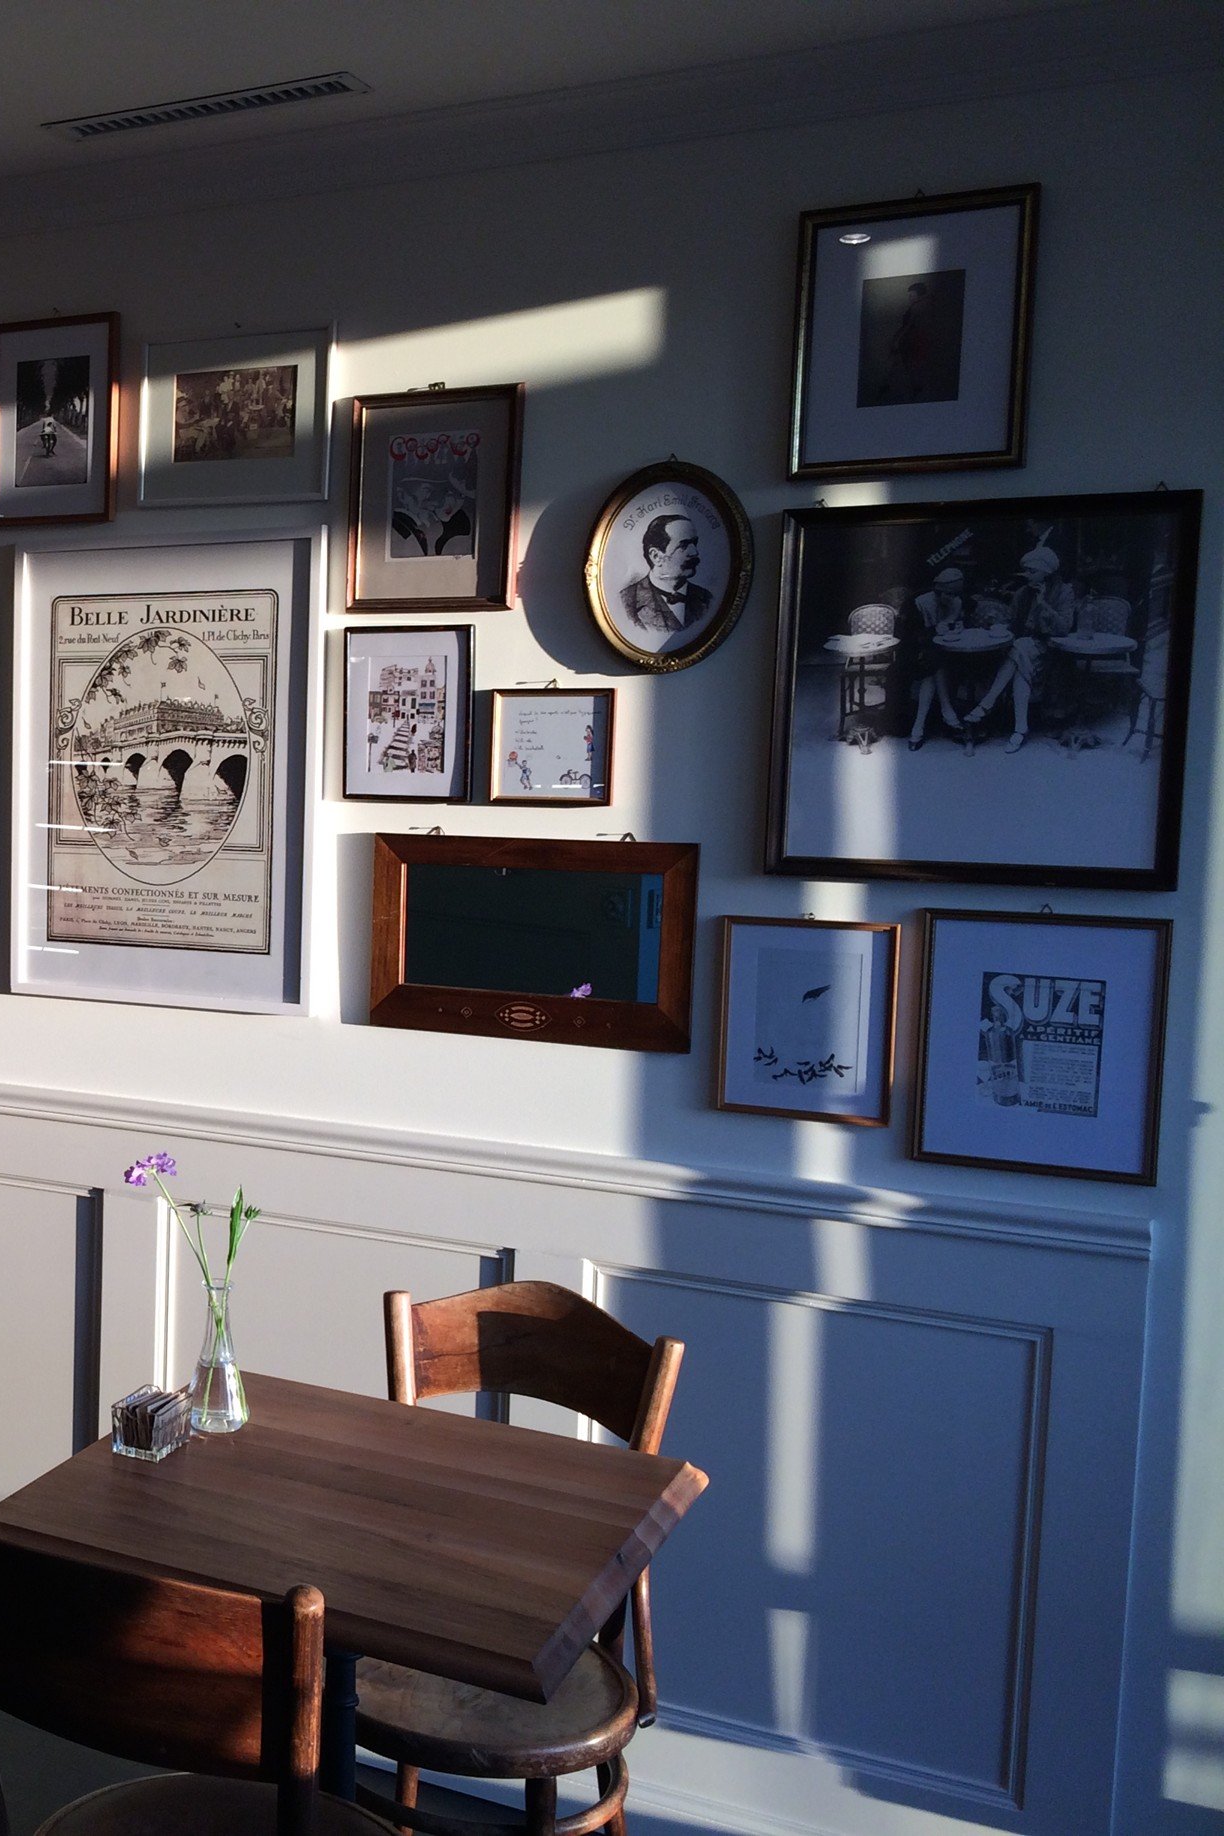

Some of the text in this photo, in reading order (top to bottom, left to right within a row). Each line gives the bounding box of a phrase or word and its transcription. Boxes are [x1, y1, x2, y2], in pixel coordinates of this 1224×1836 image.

[69, 604, 256, 626] BELLE JARDINIÈRE
[202, 892, 219, 901] SUR
[223, 893, 260, 903] MESURE
[989, 974, 1103, 1034] SUZE
[1039, 1033, 1101, 1045] GENTIANE
